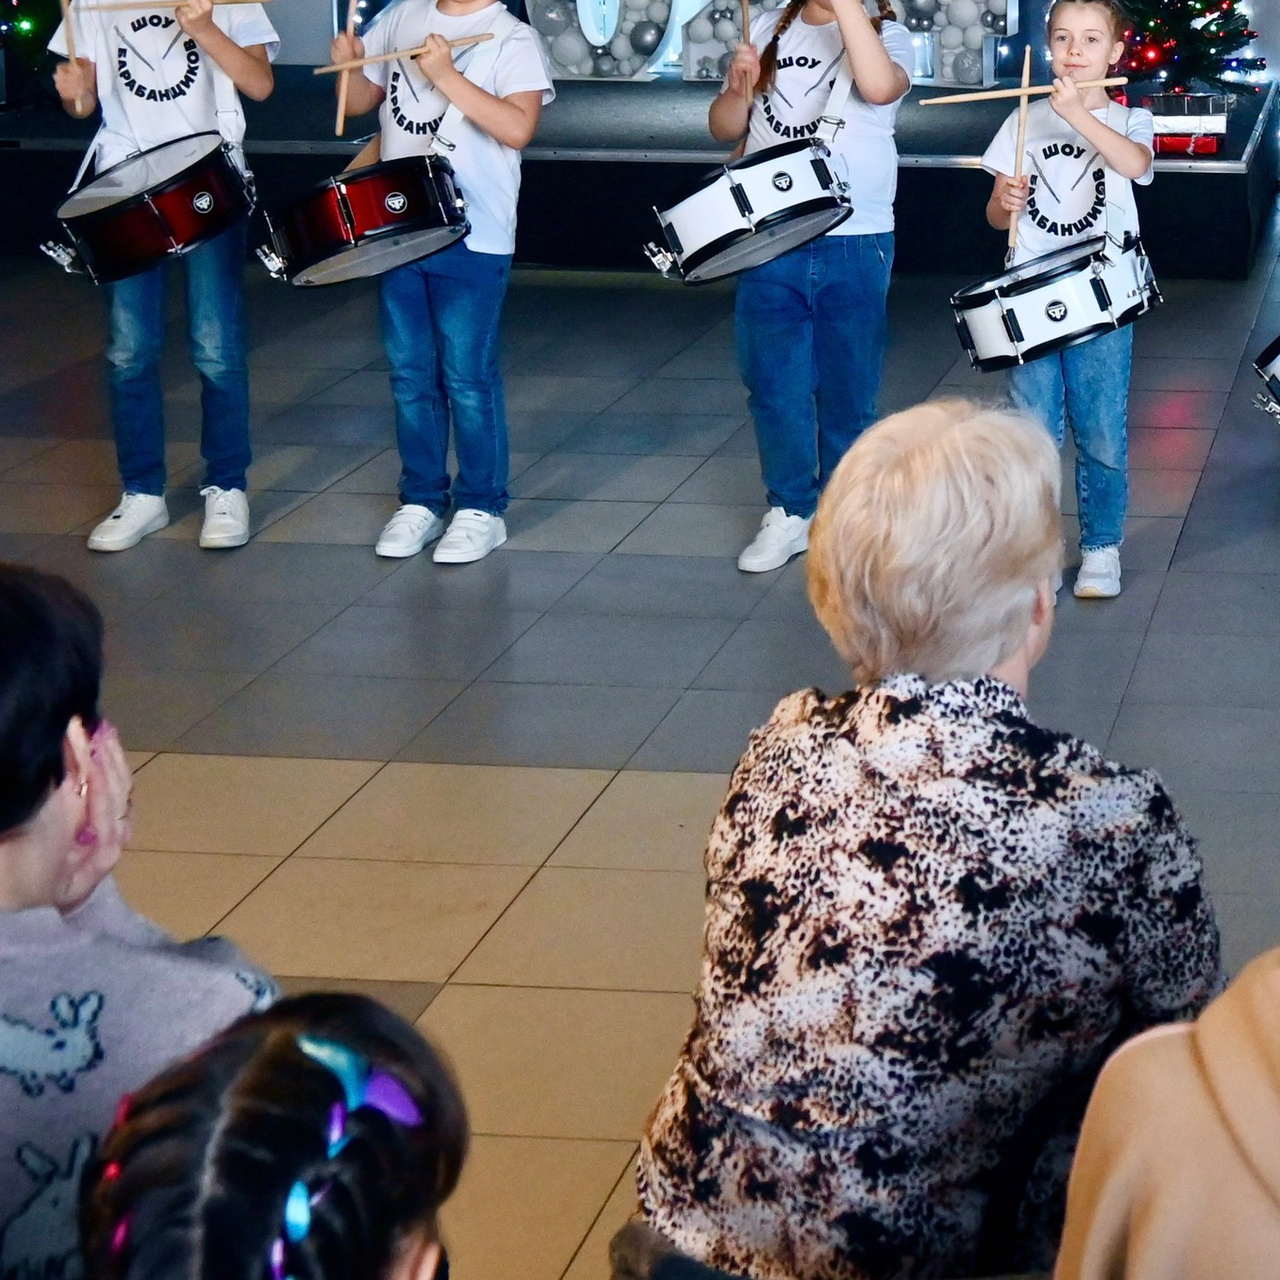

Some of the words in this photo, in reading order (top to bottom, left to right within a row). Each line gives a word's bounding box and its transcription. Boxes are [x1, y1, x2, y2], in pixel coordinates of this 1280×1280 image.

[130, 14, 175, 33] ШОУ
[117, 38, 200, 102] БАРАБАНЩИКОВ
[776, 56, 822, 70] ШОУ
[1042, 142, 1087, 161] ШОУ
[1026, 167, 1107, 237] БАРАБАНЩИКОВ
